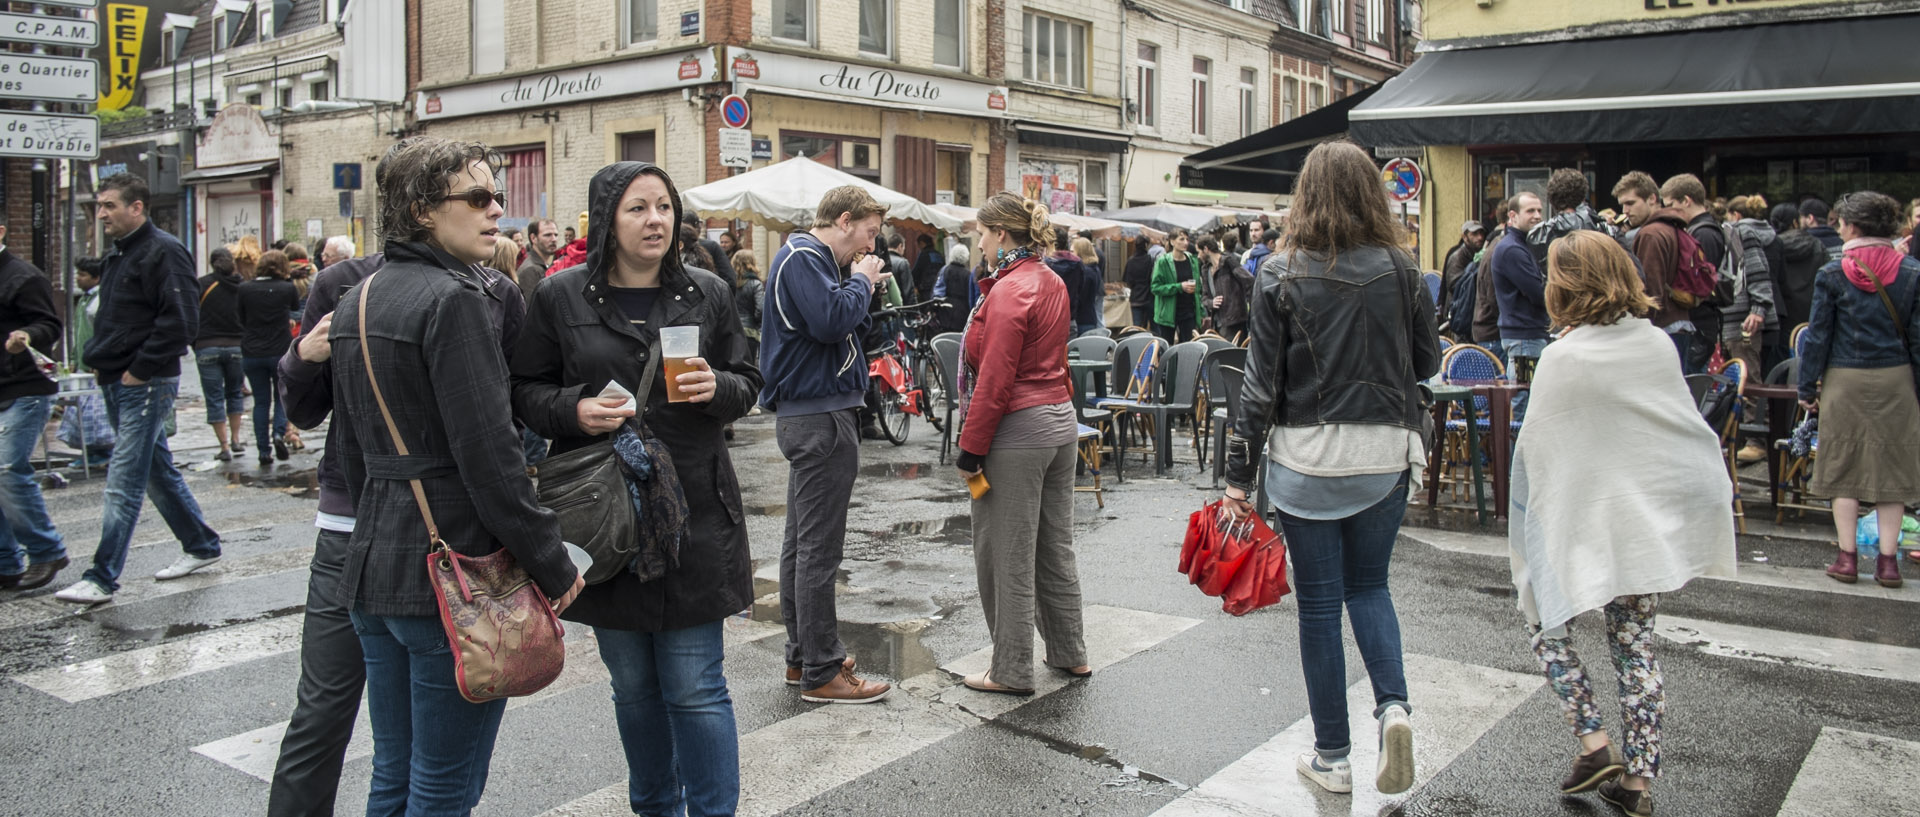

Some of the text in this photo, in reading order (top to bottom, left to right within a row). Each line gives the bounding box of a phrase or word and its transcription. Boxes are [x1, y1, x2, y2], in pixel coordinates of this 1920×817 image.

[15, 21, 90, 40] C.P.A.M.
[115, 7, 137, 91] FELIX
[19, 62, 90, 78] Quartier
[736, 62, 756, 70] STELLA
[501, 71, 604, 103] Au Presto
[819, 65, 942, 100] Au Presto
[7, 119, 27, 133] de
[23, 137, 92, 152] Durable
